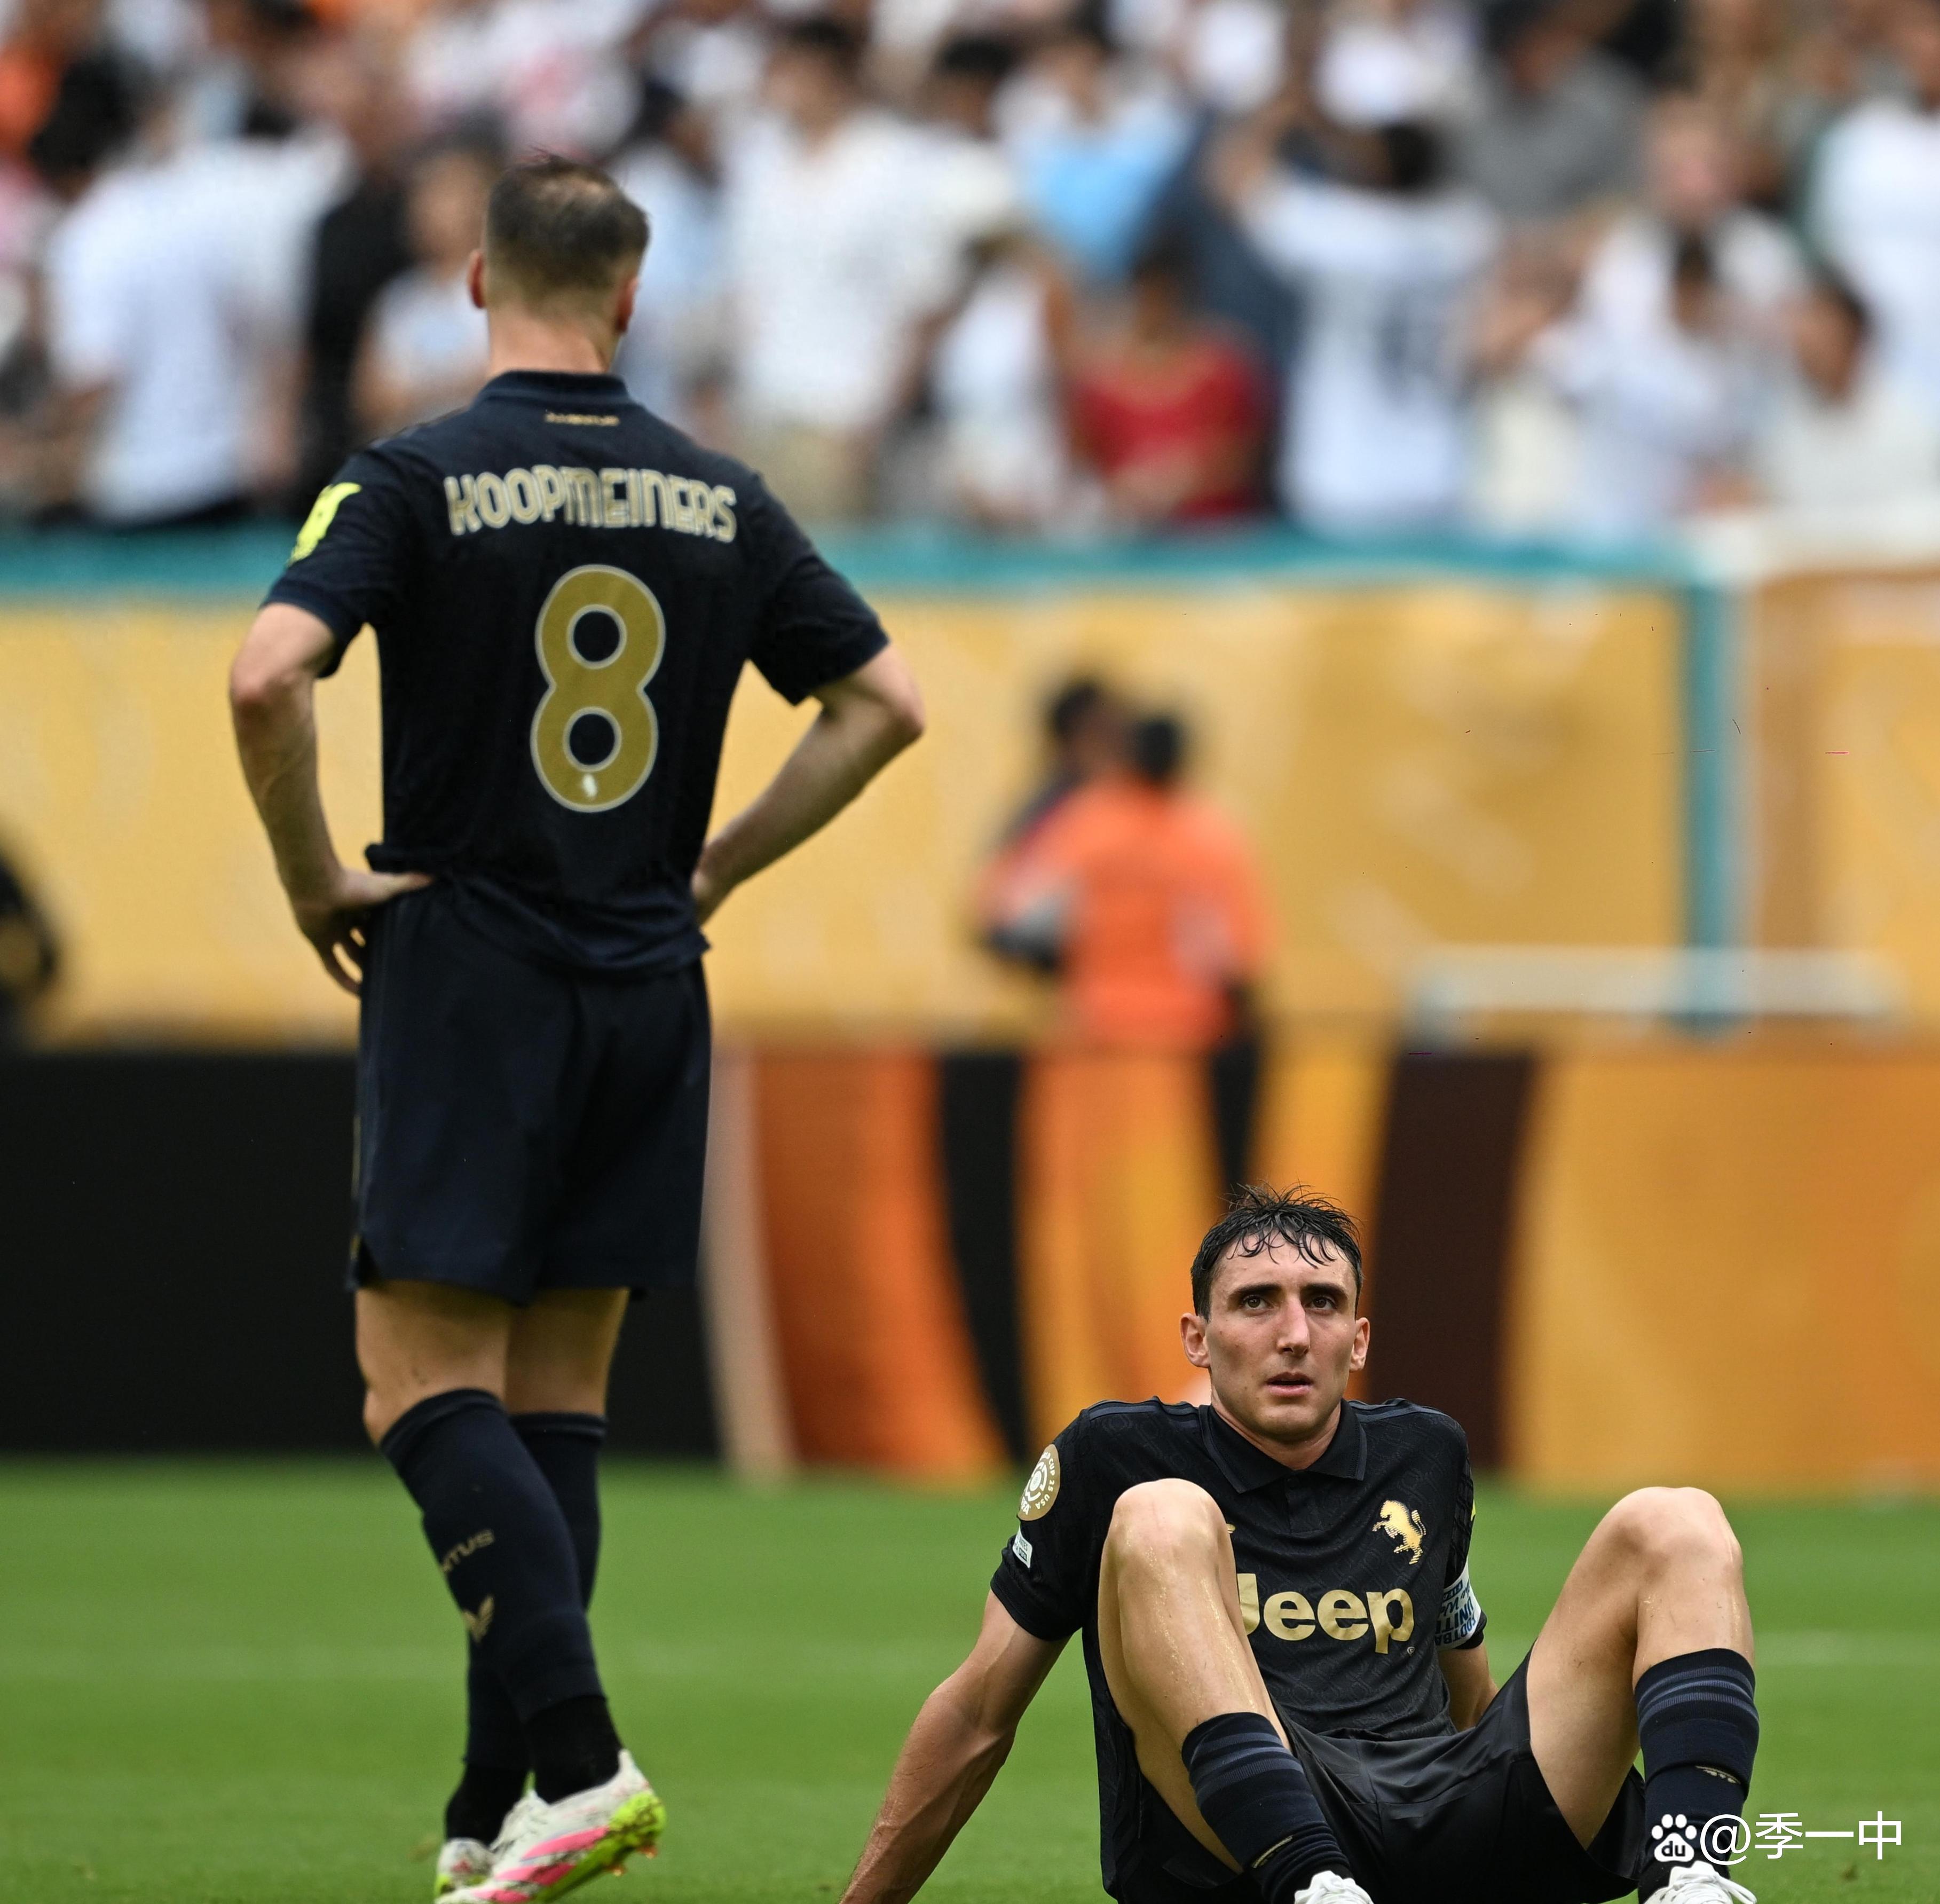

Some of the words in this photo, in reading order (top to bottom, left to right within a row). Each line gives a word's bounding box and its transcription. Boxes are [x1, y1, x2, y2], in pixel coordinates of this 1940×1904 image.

[444, 465, 737, 544] KOOPMEINERS
[530, 564, 666, 813] 8
[1047, 1479, 1055, 1492] 25
[1048, 1458, 1056, 1476] CUP
[1035, 1493, 1051, 1510] USA
[1237, 1573, 1415, 1654] Jeep
